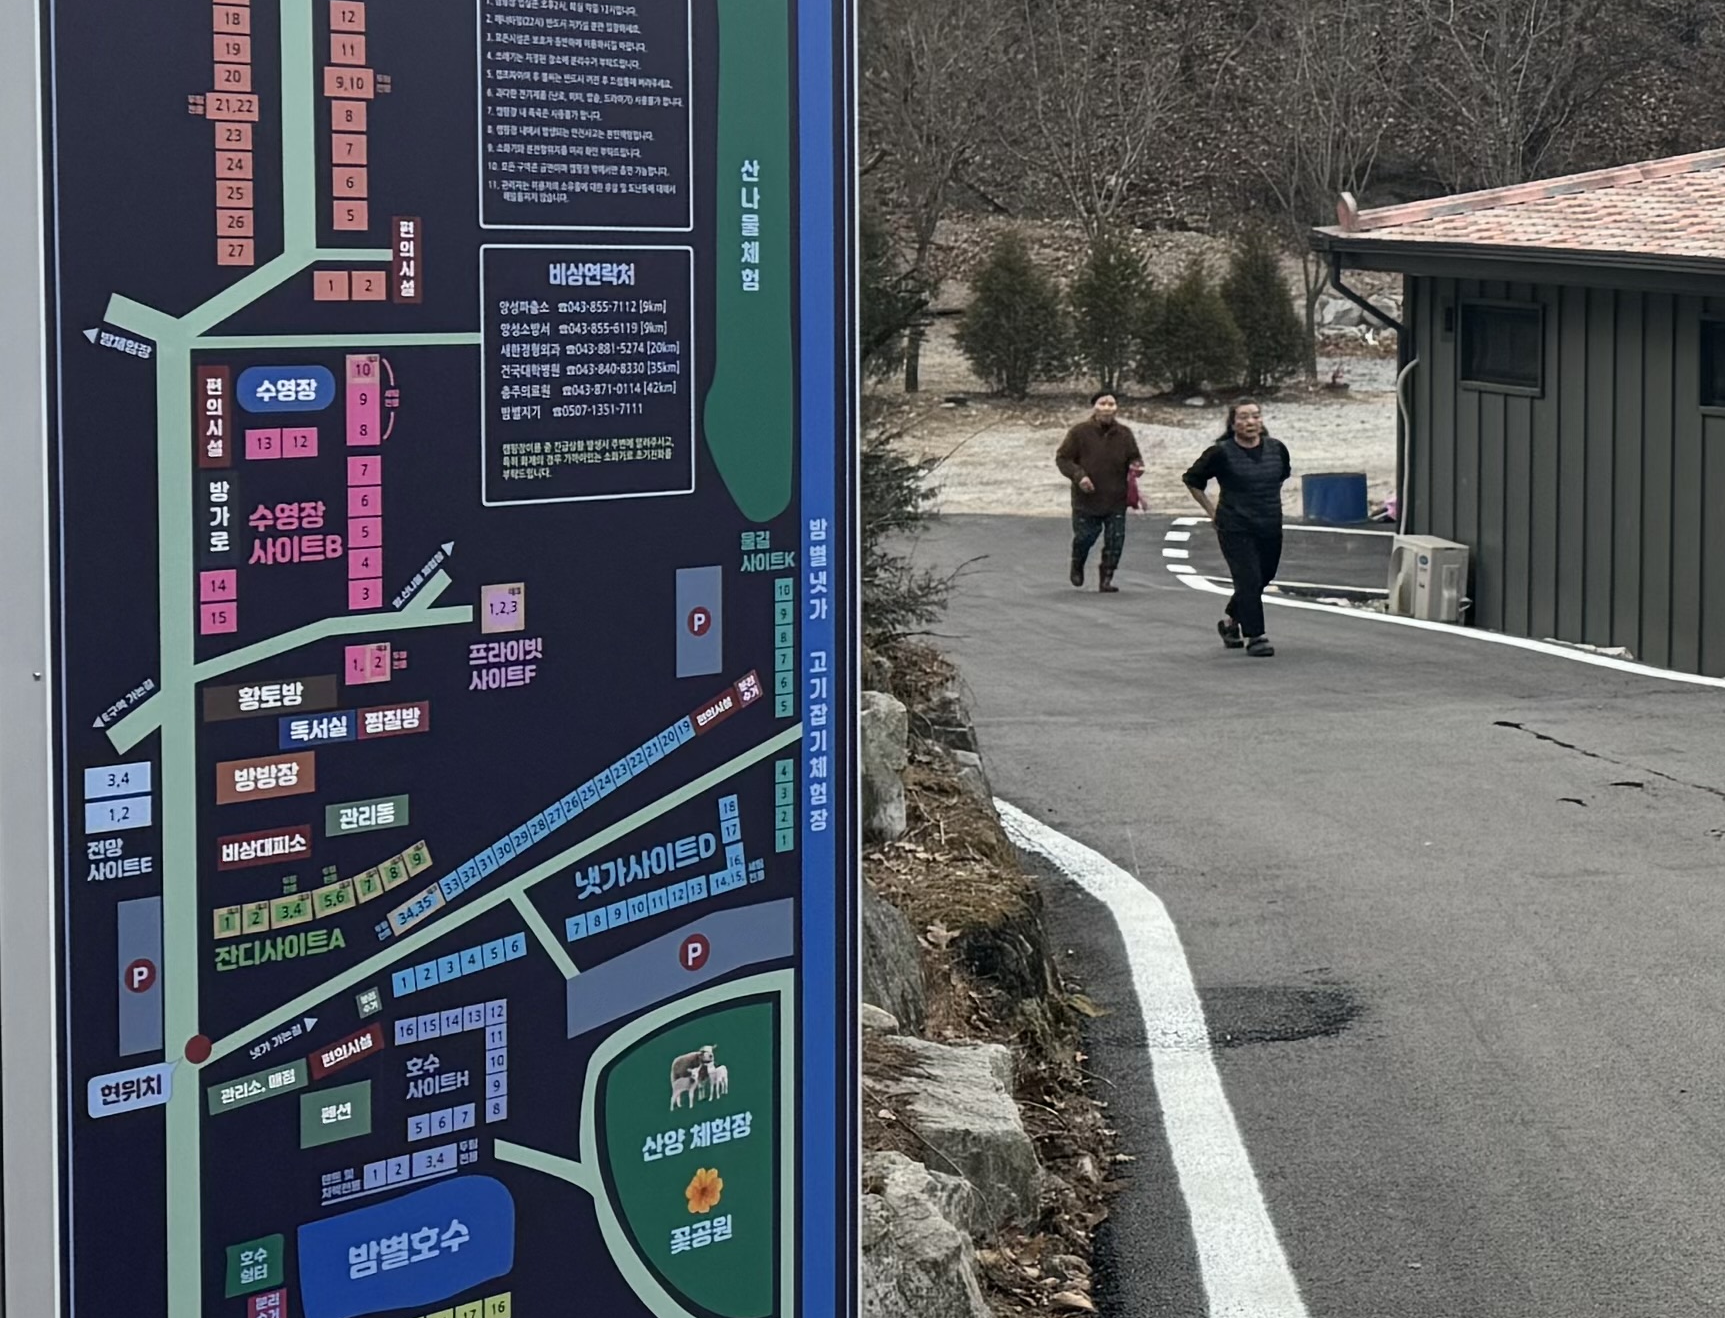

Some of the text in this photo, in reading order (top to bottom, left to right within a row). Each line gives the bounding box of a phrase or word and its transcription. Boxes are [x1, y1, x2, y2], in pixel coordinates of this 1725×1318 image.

[225, 13, 240, 26] 18
[341, 11, 355, 23] 12
[225, 42, 241, 55] 19
[342, 44, 355, 56] 11
[224, 71, 241, 83] 20
[336, 77, 364, 91] 9,10
[215, 99, 254, 113] 21,22
[345, 110, 353, 122] 8
[226, 129, 242, 142] 23
[346, 143, 353, 156] 7
[226, 158, 243, 171] 24
[227, 187, 244, 200] 25
[346, 176, 354, 189] 6
[227, 216, 244, 228] 26
[347, 209, 354, 222] 5
[741, 160, 760, 291] 산나물체험
[228, 245, 244, 257] 27
[399, 220, 415, 298] 편의시설
[329, 280, 333, 292] 1
[364, 279, 372, 292] 2
[549, 263, 634, 286] 비상연락처
[256, 378, 317, 402] 수영장
[206, 378, 223, 458] 편의시설
[501, 405, 541, 420] 밤별지기
[209, 481, 230, 553] 방가로
[249, 501, 326, 532] 수영장
[248, 534, 343, 565] 사이트B
[740, 551, 795, 572] 사이트K
[693, 613, 706, 631] P
[468, 637, 543, 665] 프라이빗
[468, 665, 536, 691] 사이트F
[809, 519, 828, 832] 밤별냇가 고기잡기체험장
[238, 682, 304, 711] 황토방
[290, 716, 347, 741] 독서실
[364, 709, 421, 734] 찜질방
[234, 762, 300, 792] 방방장
[339, 802, 395, 830] 관리동
[87, 838, 123, 860] 전망
[221, 834, 307, 862] 비상대피소
[87, 857, 153, 881] 사이트E
[575, 833, 716, 900] 냇가사이트D
[215, 928, 345, 971] 잔디사이트A
[687, 942, 702, 966] P
[132, 967, 149, 988] P
[321, 1033, 373, 1068] 편의시설
[406, 1053, 440, 1077] 호수
[100, 1074, 162, 1106] 현위치
[406, 1070, 469, 1100] 사이트H
[321, 1102, 352, 1124] 펜션
[641, 1110, 753, 1162] 산양 체험장
[670, 1214, 733, 1255] 꽃공원
[240, 1247, 268, 1266] 호수
[348, 1218, 470, 1280] 밤별호수
[491, 1301, 505, 1315] 16
